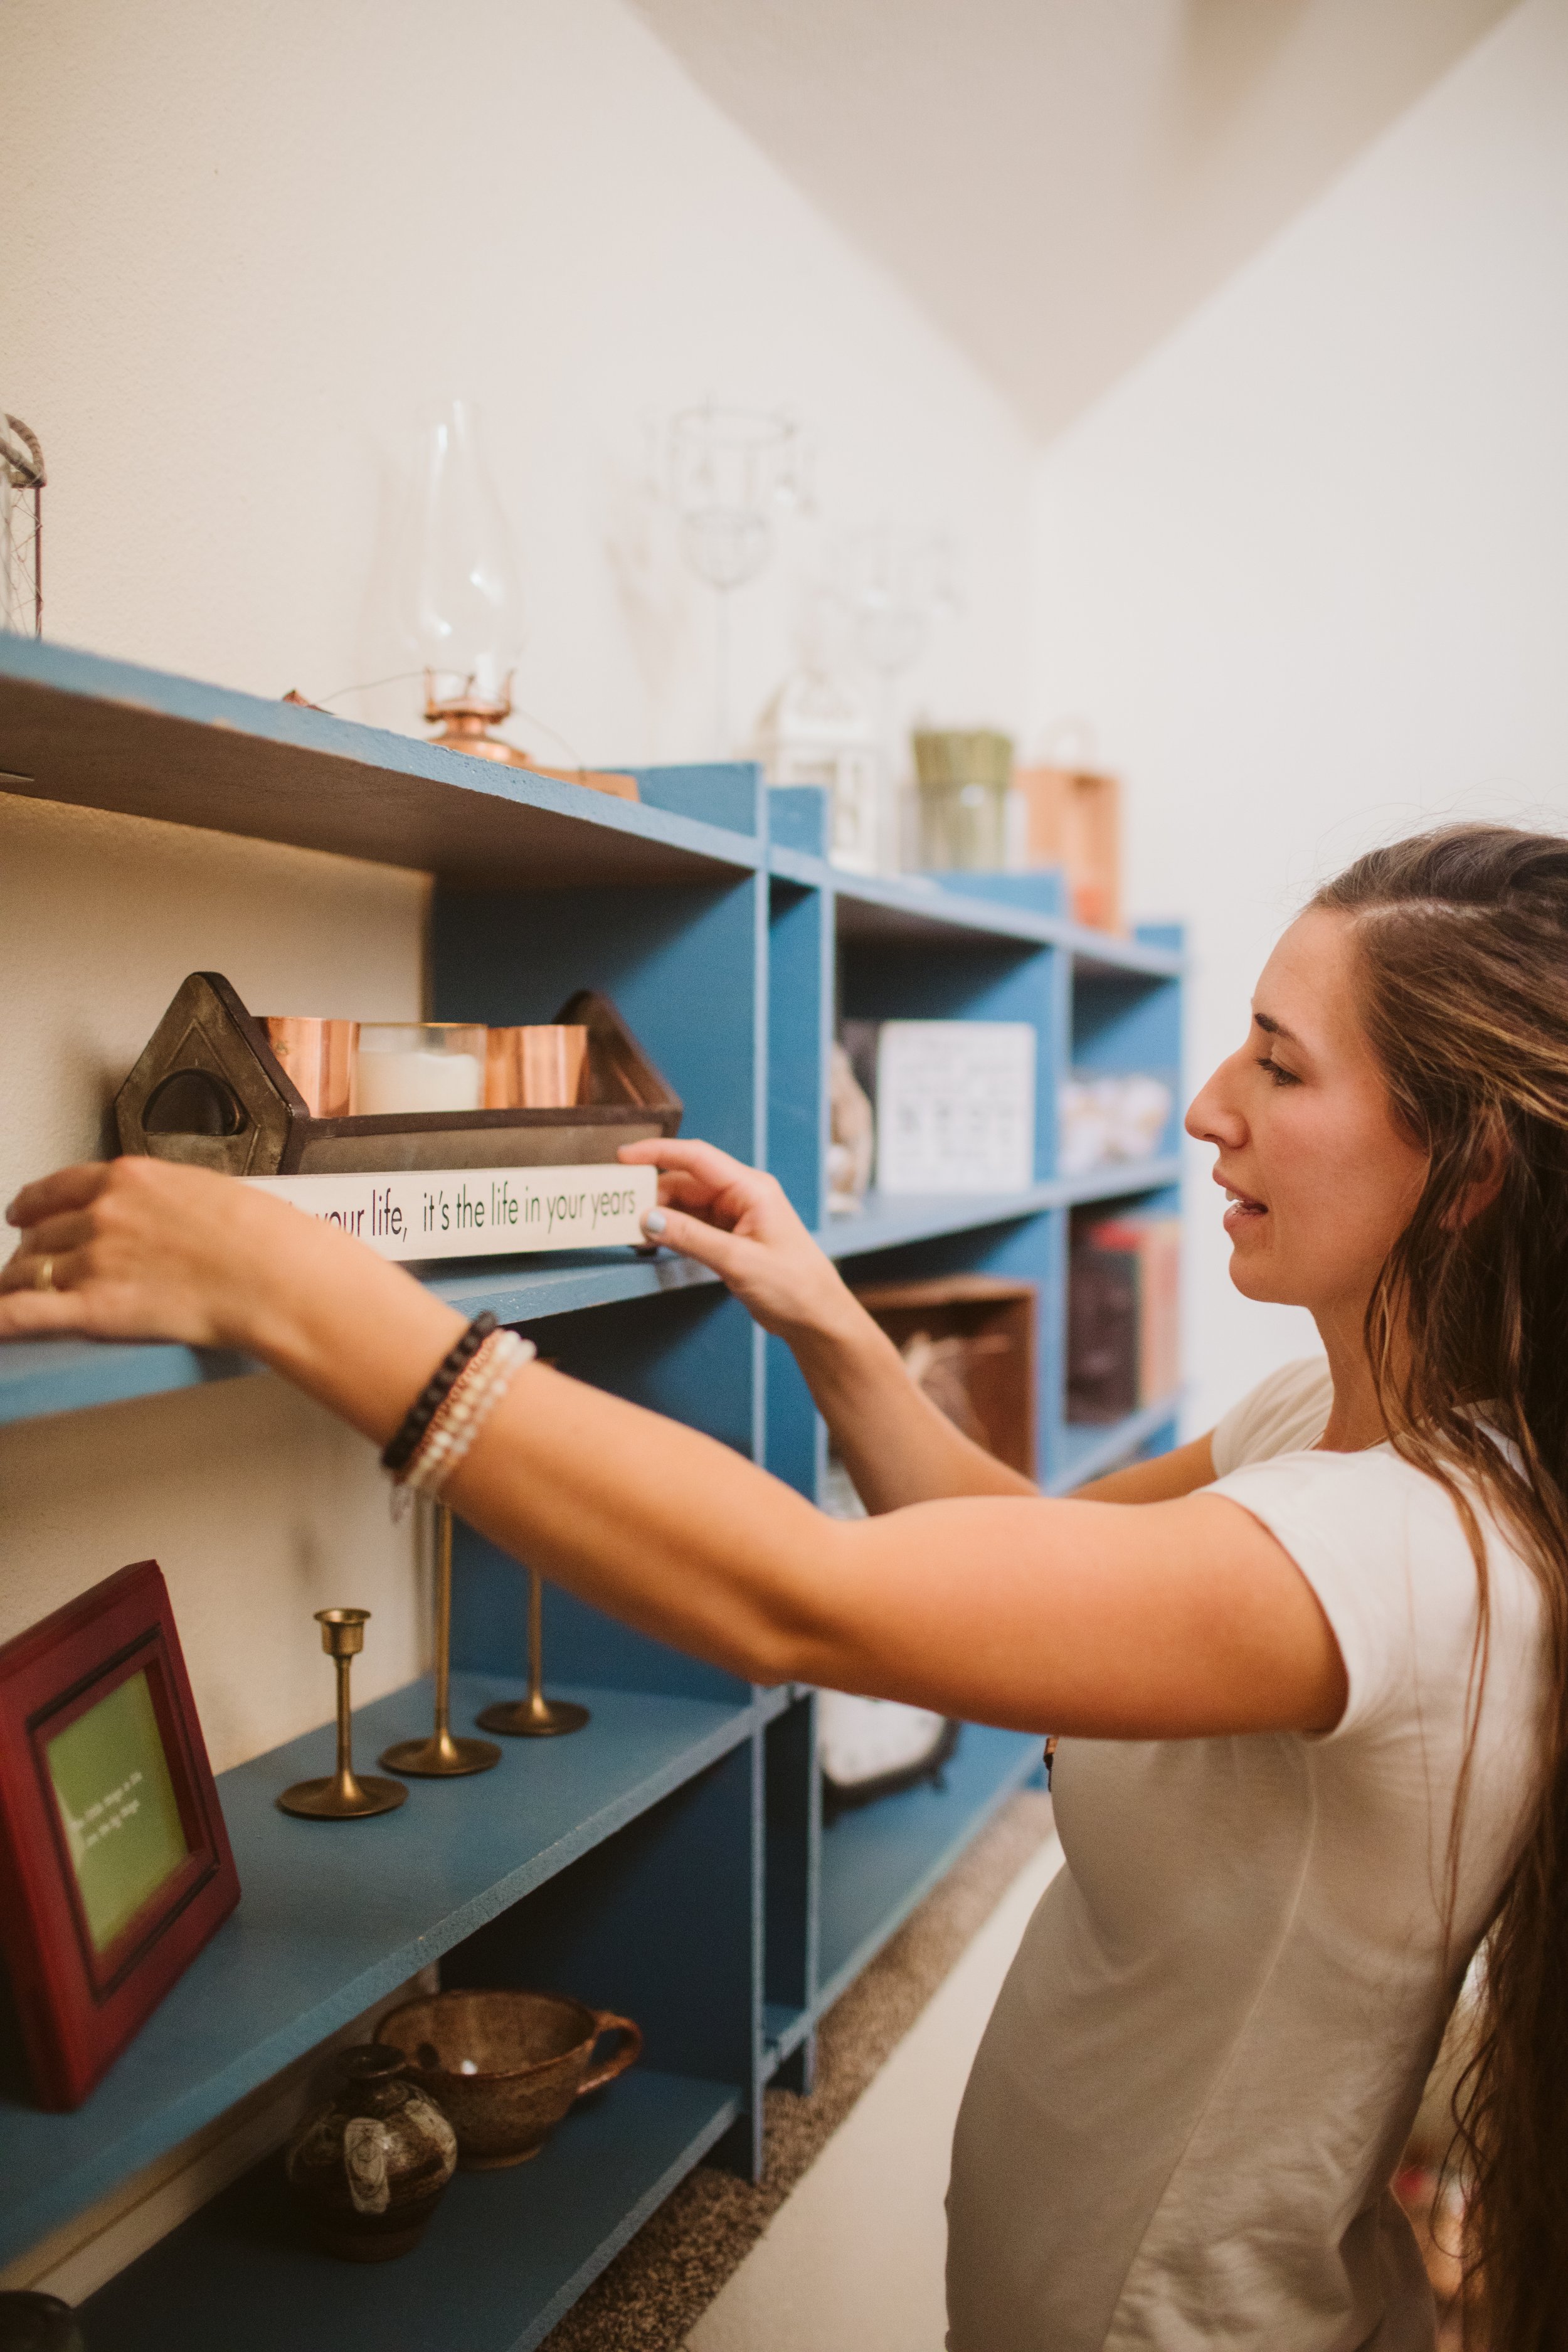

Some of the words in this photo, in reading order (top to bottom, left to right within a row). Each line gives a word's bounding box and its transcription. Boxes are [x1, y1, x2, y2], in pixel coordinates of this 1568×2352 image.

[315, 1209, 365, 1237] our
[372, 1187, 408, 1242] life,
[423, 1190, 450, 1231] it's
[457, 1184, 485, 1227] the
[492, 1180, 518, 1225] life
[526, 1186, 540, 1222] in
[547, 1194, 586, 1234] your
[591, 1189, 635, 1230] years
